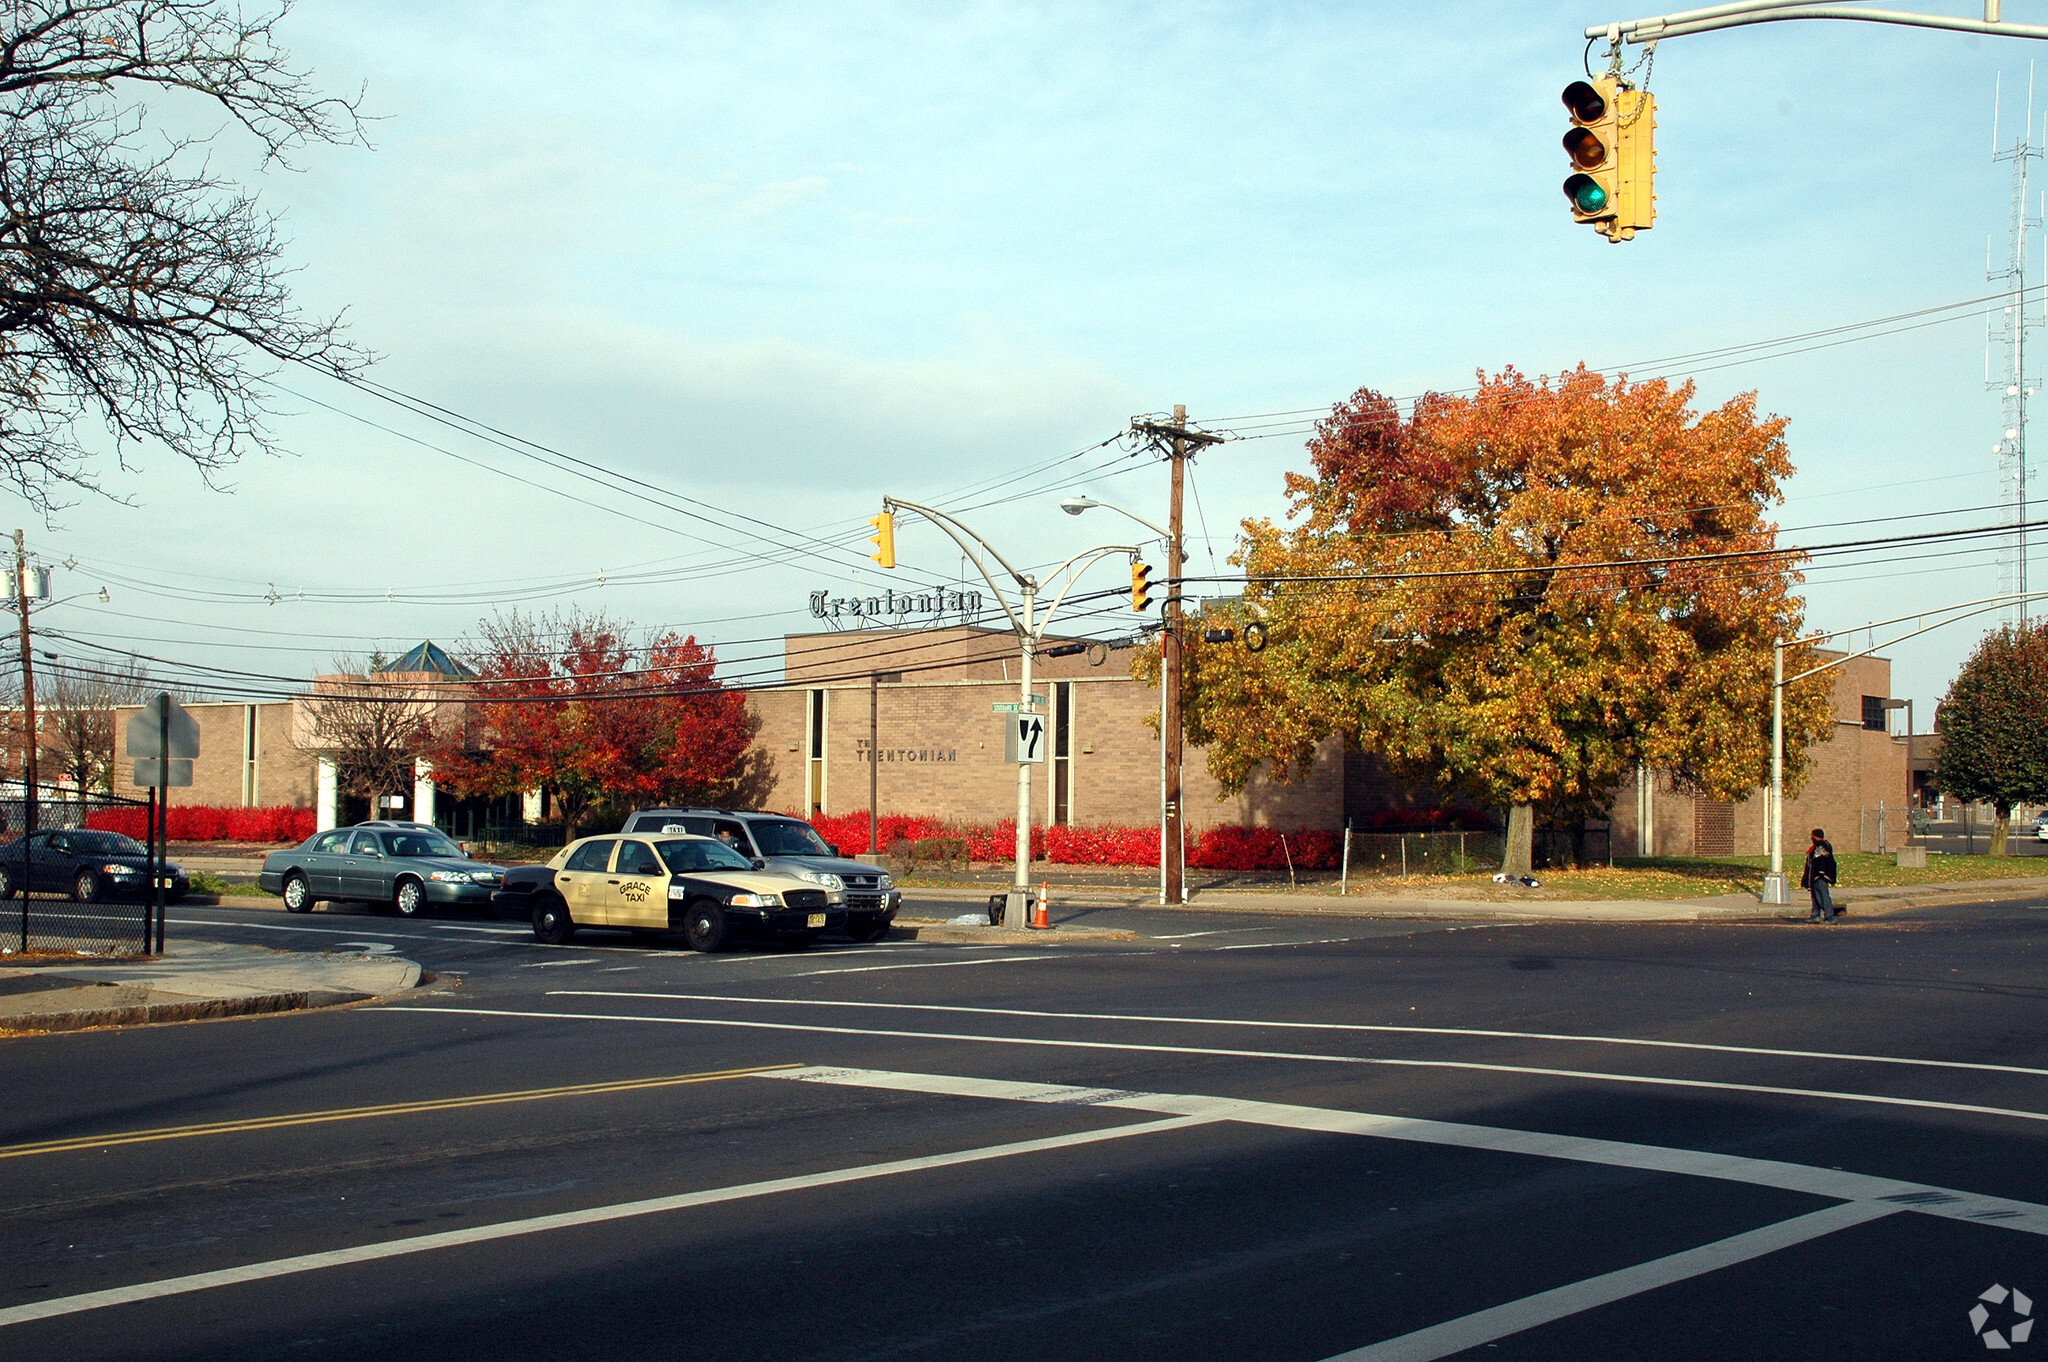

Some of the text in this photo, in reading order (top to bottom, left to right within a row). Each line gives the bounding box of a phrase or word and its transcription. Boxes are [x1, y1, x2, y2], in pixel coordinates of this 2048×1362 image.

[809, 587, 983, 618] Trentonian
[620, 881, 651, 895] GRACE
[625, 893, 645, 902] TAXI
